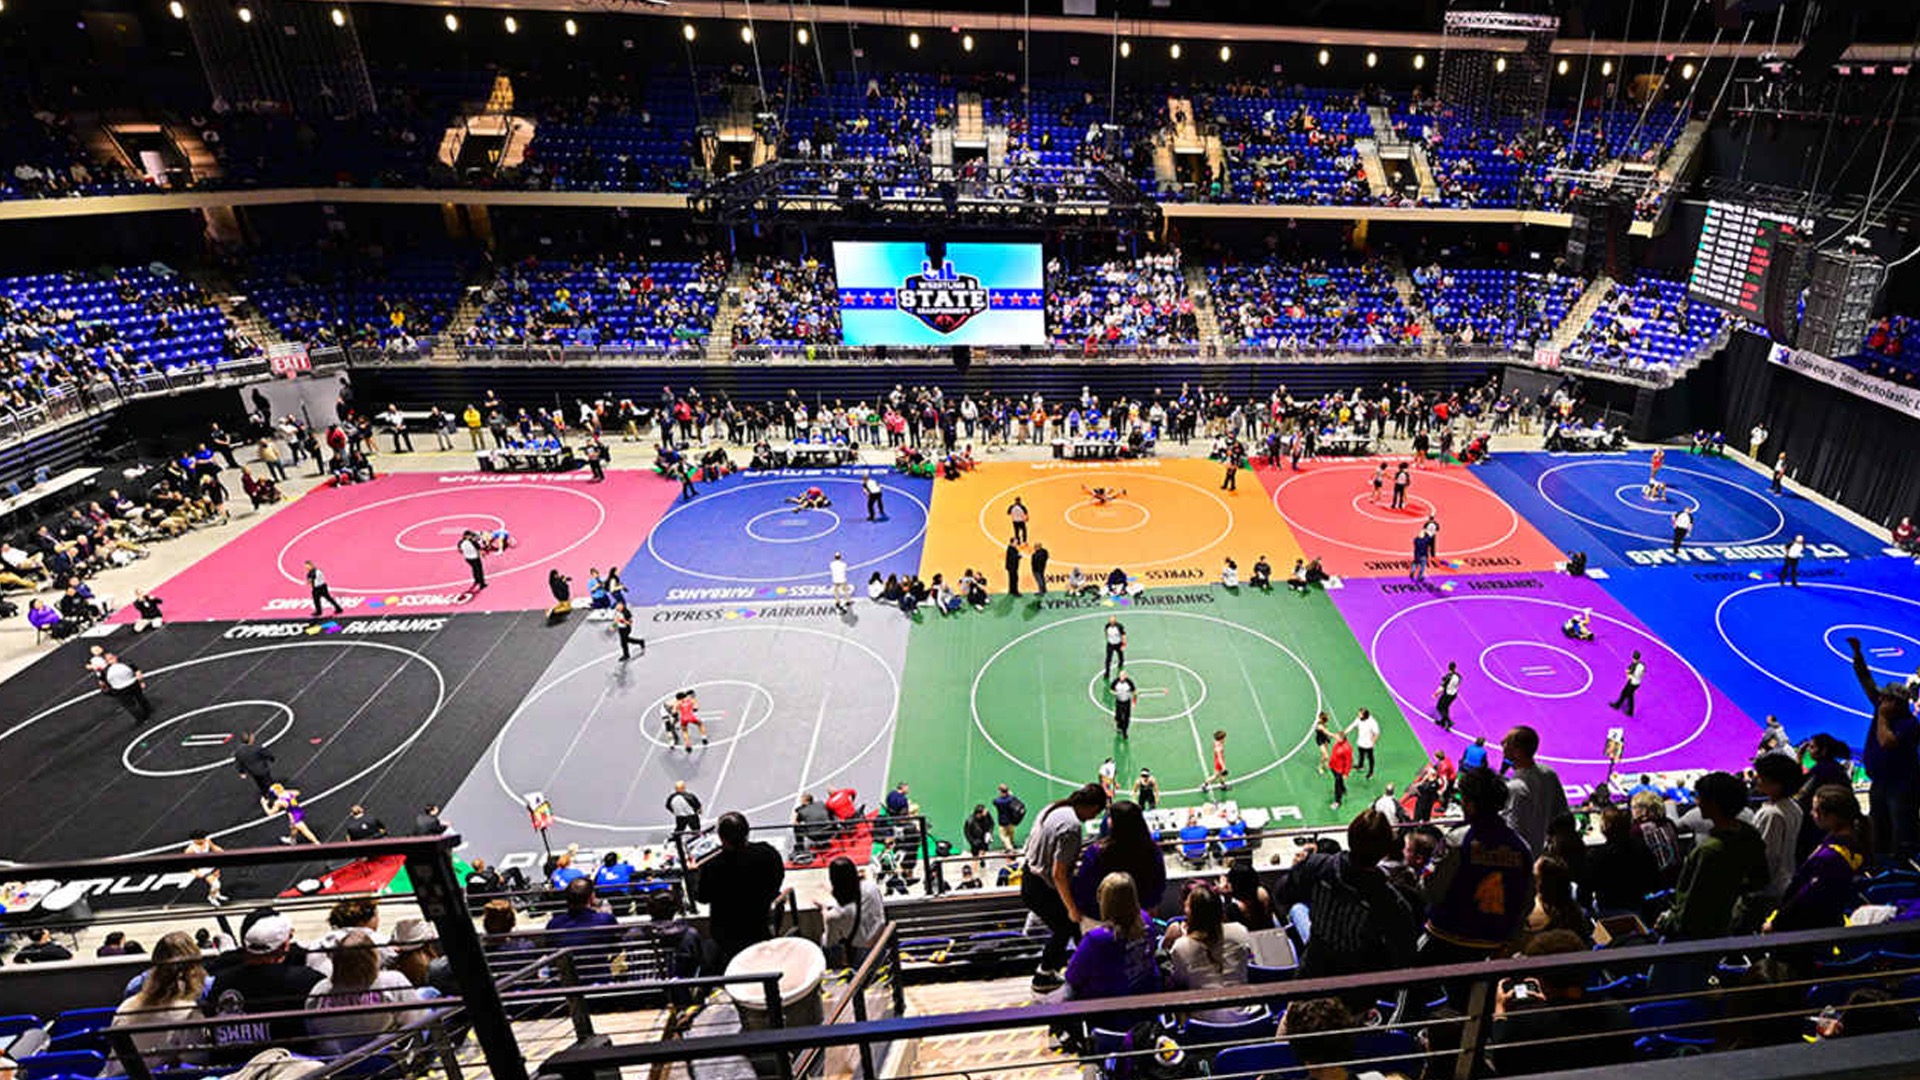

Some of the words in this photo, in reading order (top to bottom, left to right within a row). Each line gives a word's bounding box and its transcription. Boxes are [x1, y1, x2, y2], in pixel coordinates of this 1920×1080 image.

[899, 290, 986, 308] STATE
[272, 353, 311, 373] EXIT
[1793, 354, 1838, 380] University
[1839, 371, 1914, 408] Interscholastic
[1624, 546, 1716, 565] RAMS
[1144, 568, 1205, 580] CYPRESS
[664, 586, 756, 601] FAIRBANKS
[1132, 593, 1215, 607] FAIRBANKS
[651, 607, 724, 622] CYPRESS
[223, 622, 309, 639] CYPRESS
[341, 617, 448, 634] FAIRBANKS
